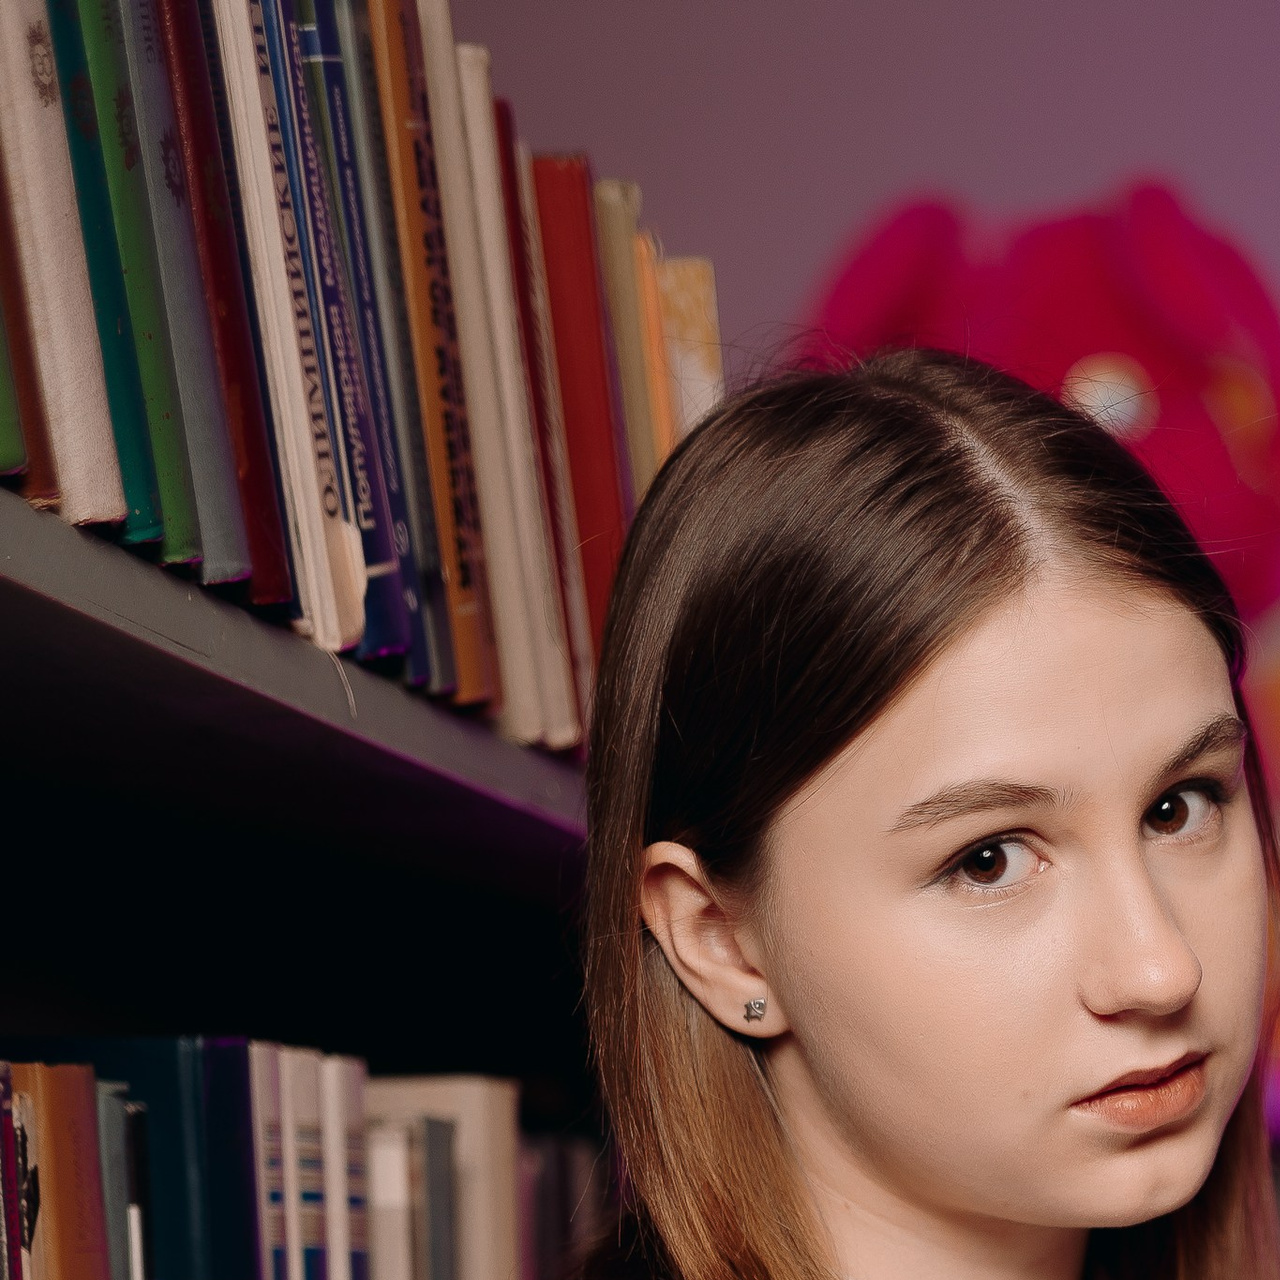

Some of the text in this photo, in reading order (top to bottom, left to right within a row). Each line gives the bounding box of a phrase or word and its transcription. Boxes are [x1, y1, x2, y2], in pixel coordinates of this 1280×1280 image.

[252, 0, 339, 518] ОЛИМПИЙСКИЕ ИГ
[288, 21, 342, 288] медицинская
[328, 303, 376, 530] Популярная
